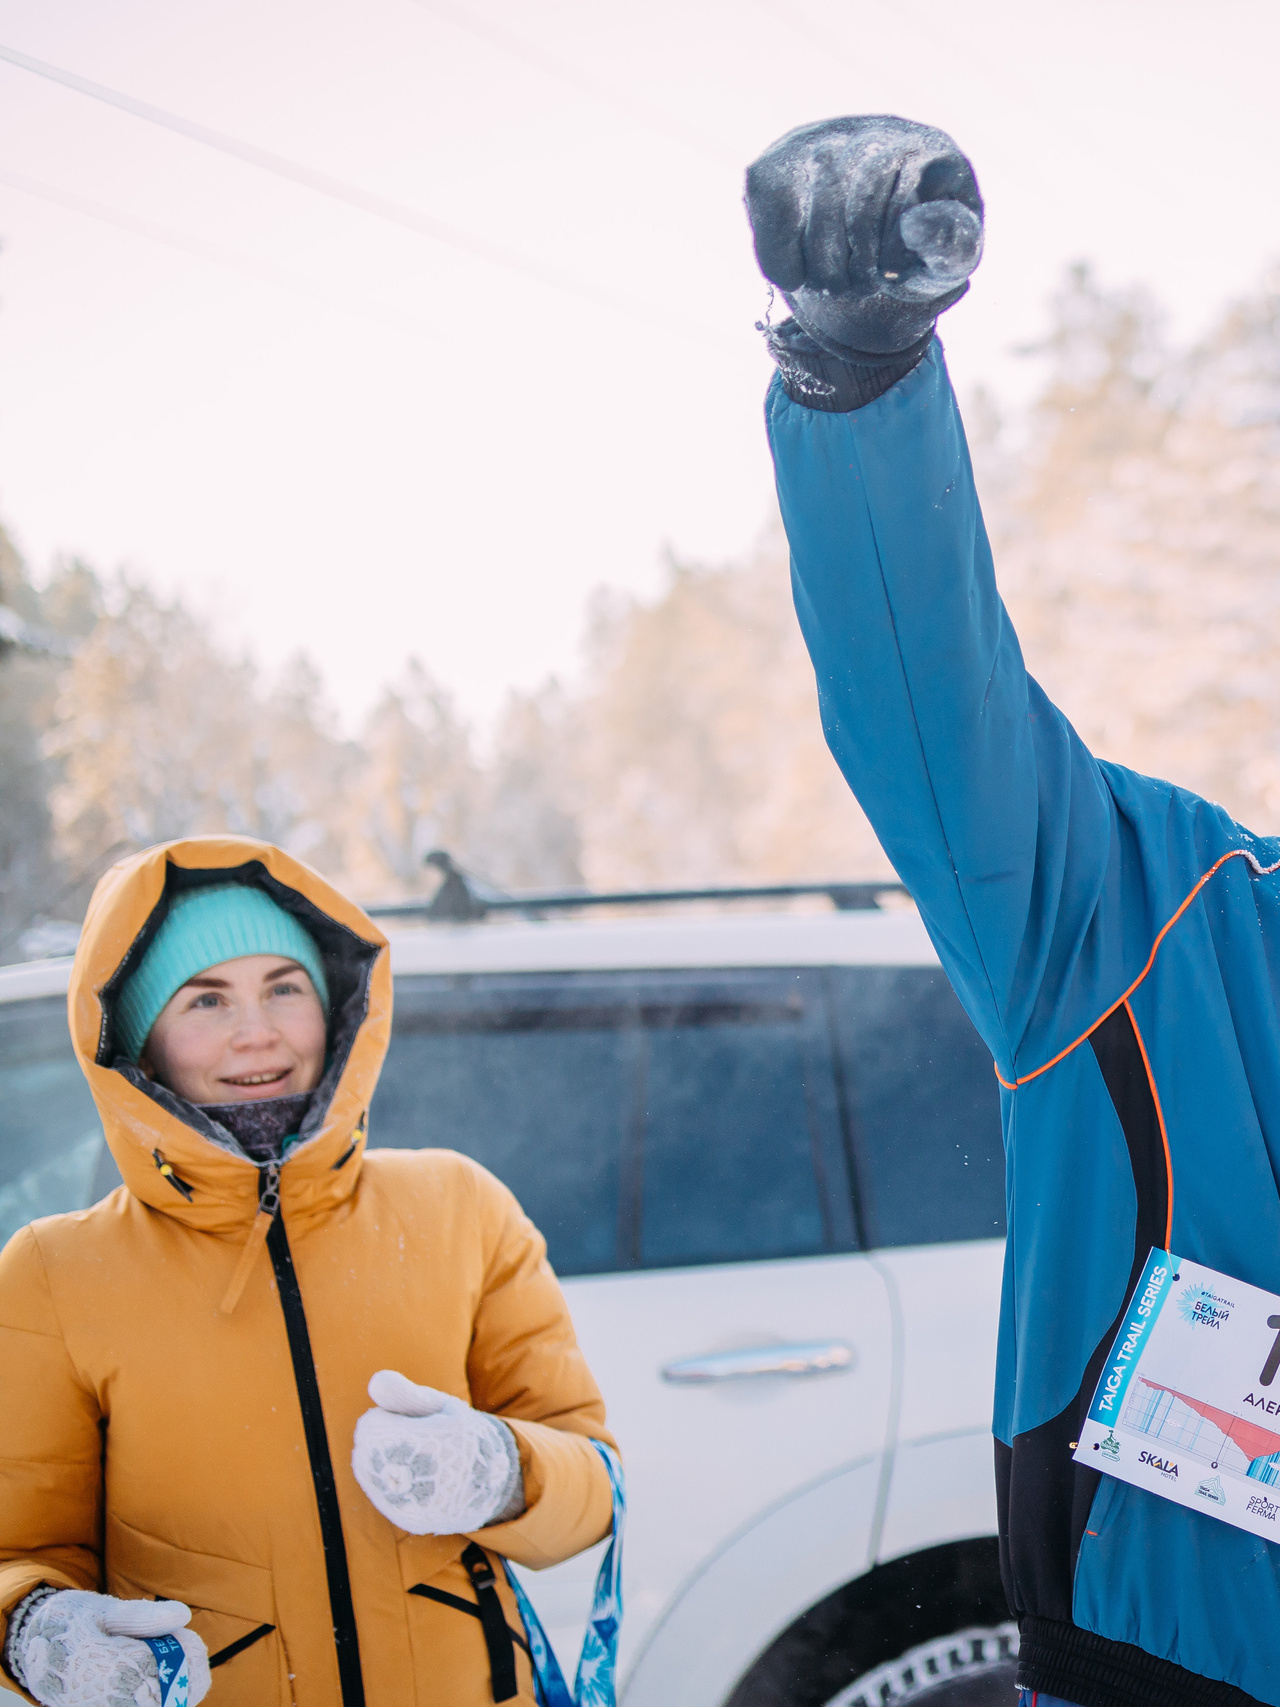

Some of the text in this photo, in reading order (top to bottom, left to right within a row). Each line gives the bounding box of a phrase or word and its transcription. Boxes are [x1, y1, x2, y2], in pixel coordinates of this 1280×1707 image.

[1191, 1310, 1220, 1330] ТРЕЙЛ
[1195, 1301, 1230, 1321] БЕЛЫЙ
[1098, 1365, 1127, 1412] TAIGA
[1116, 1320, 1147, 1362] TRAIL
[1138, 1265, 1168, 1318] SERIES
[1138, 1450, 1179, 1477] SKALA
[1160, 1471, 1177, 1482] HOTEL
[1245, 1502, 1276, 1522] FERMA
[1248, 1495, 1280, 1513] SPORT
